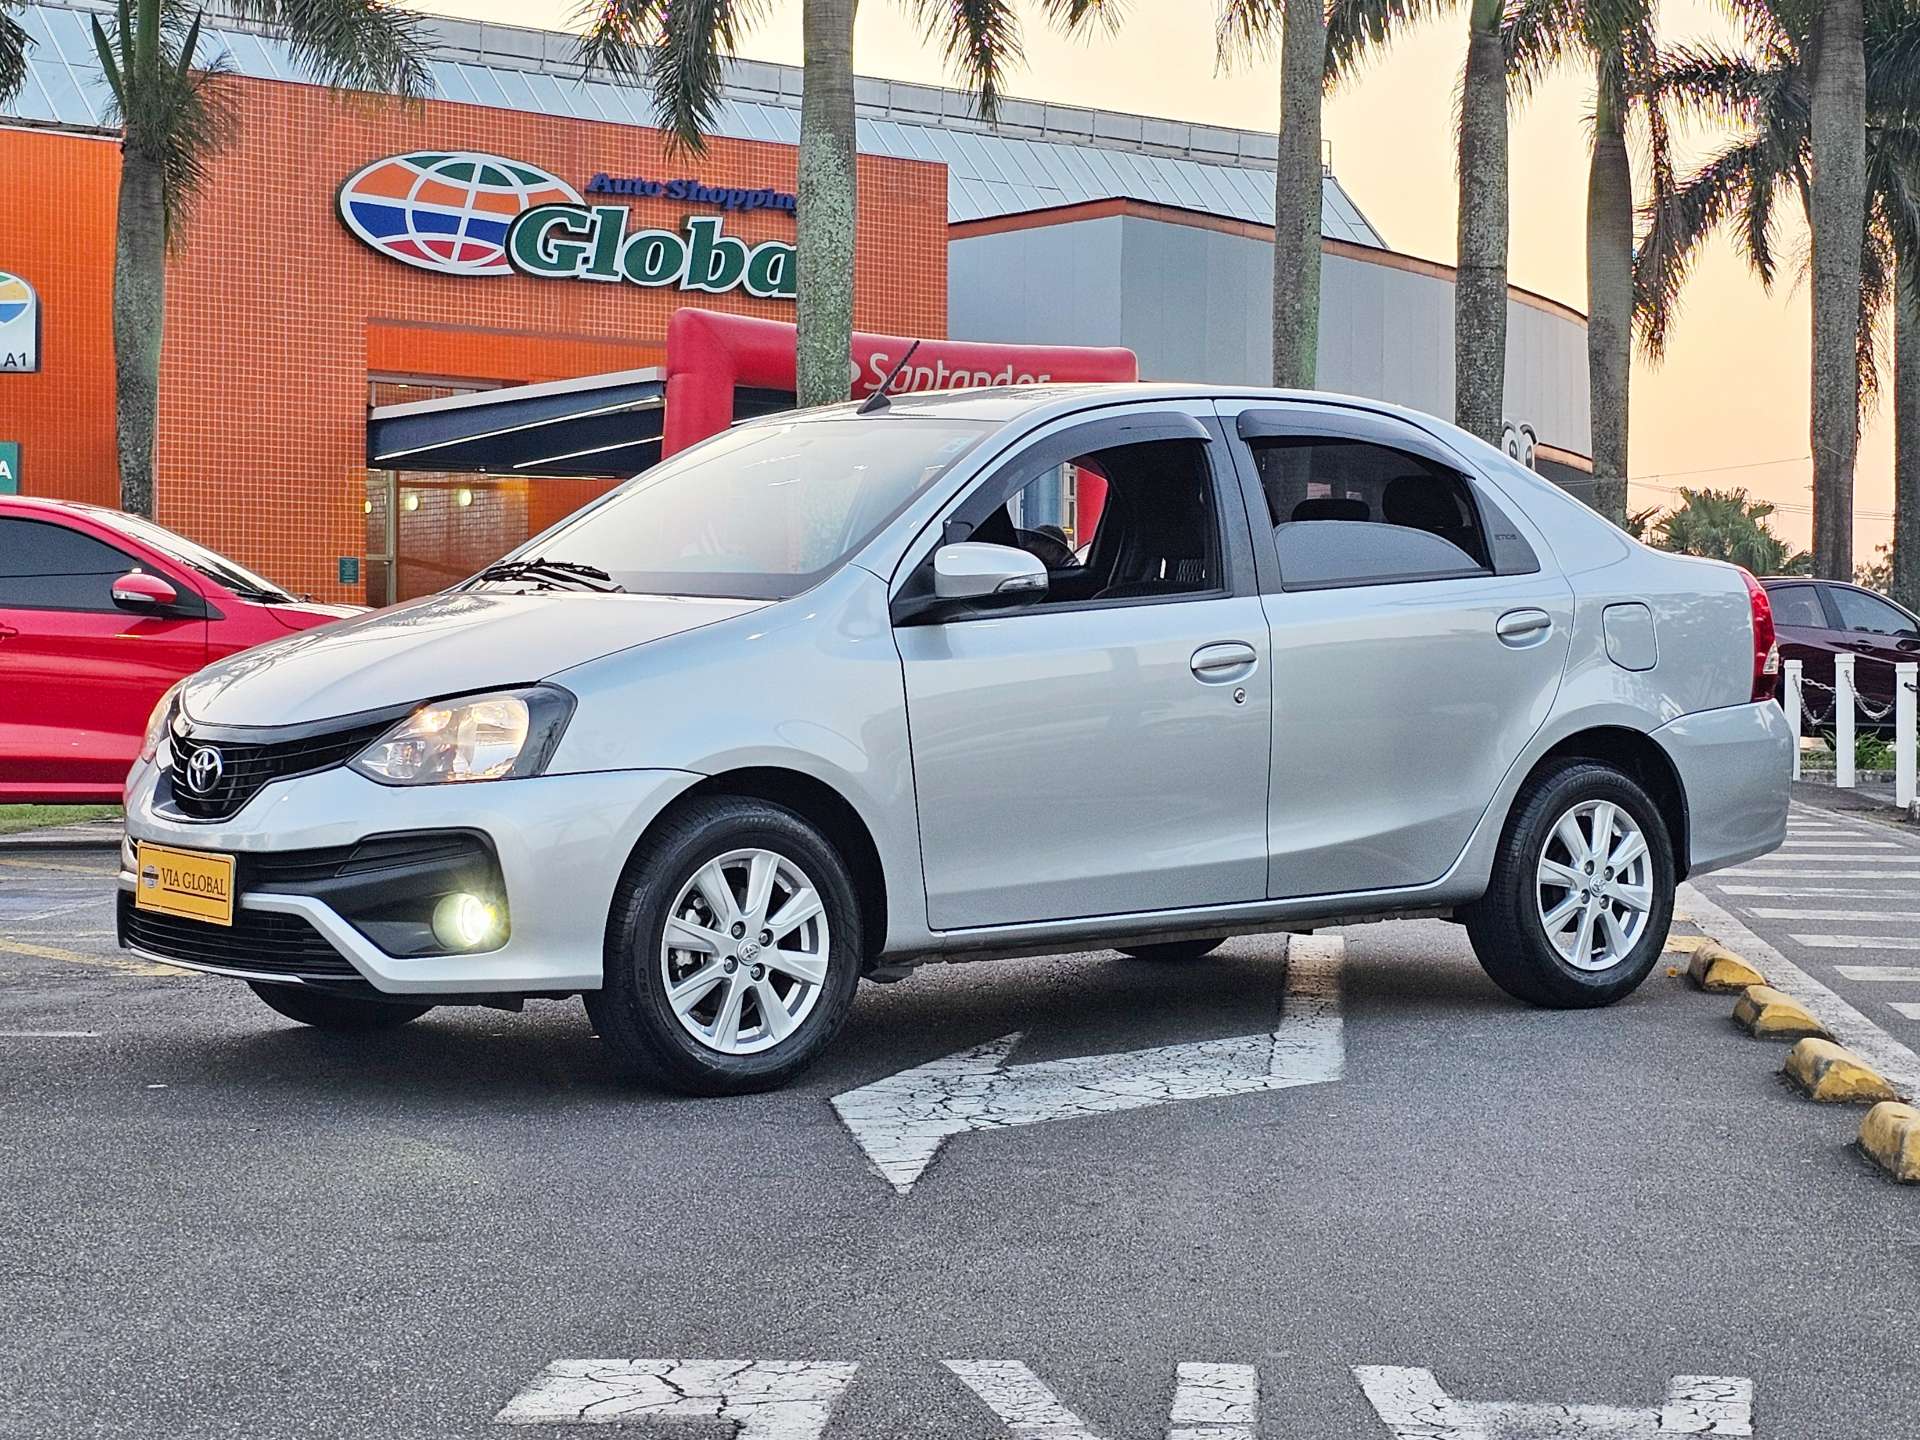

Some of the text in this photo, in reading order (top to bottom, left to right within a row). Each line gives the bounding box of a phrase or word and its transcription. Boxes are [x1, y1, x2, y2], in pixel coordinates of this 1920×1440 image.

[586, 172, 797, 216] Auto Shoppin
[506, 203, 797, 298] Globa
[4, 352, 26, 367] A1
[161, 867, 226, 896] VIA GLOBAL
